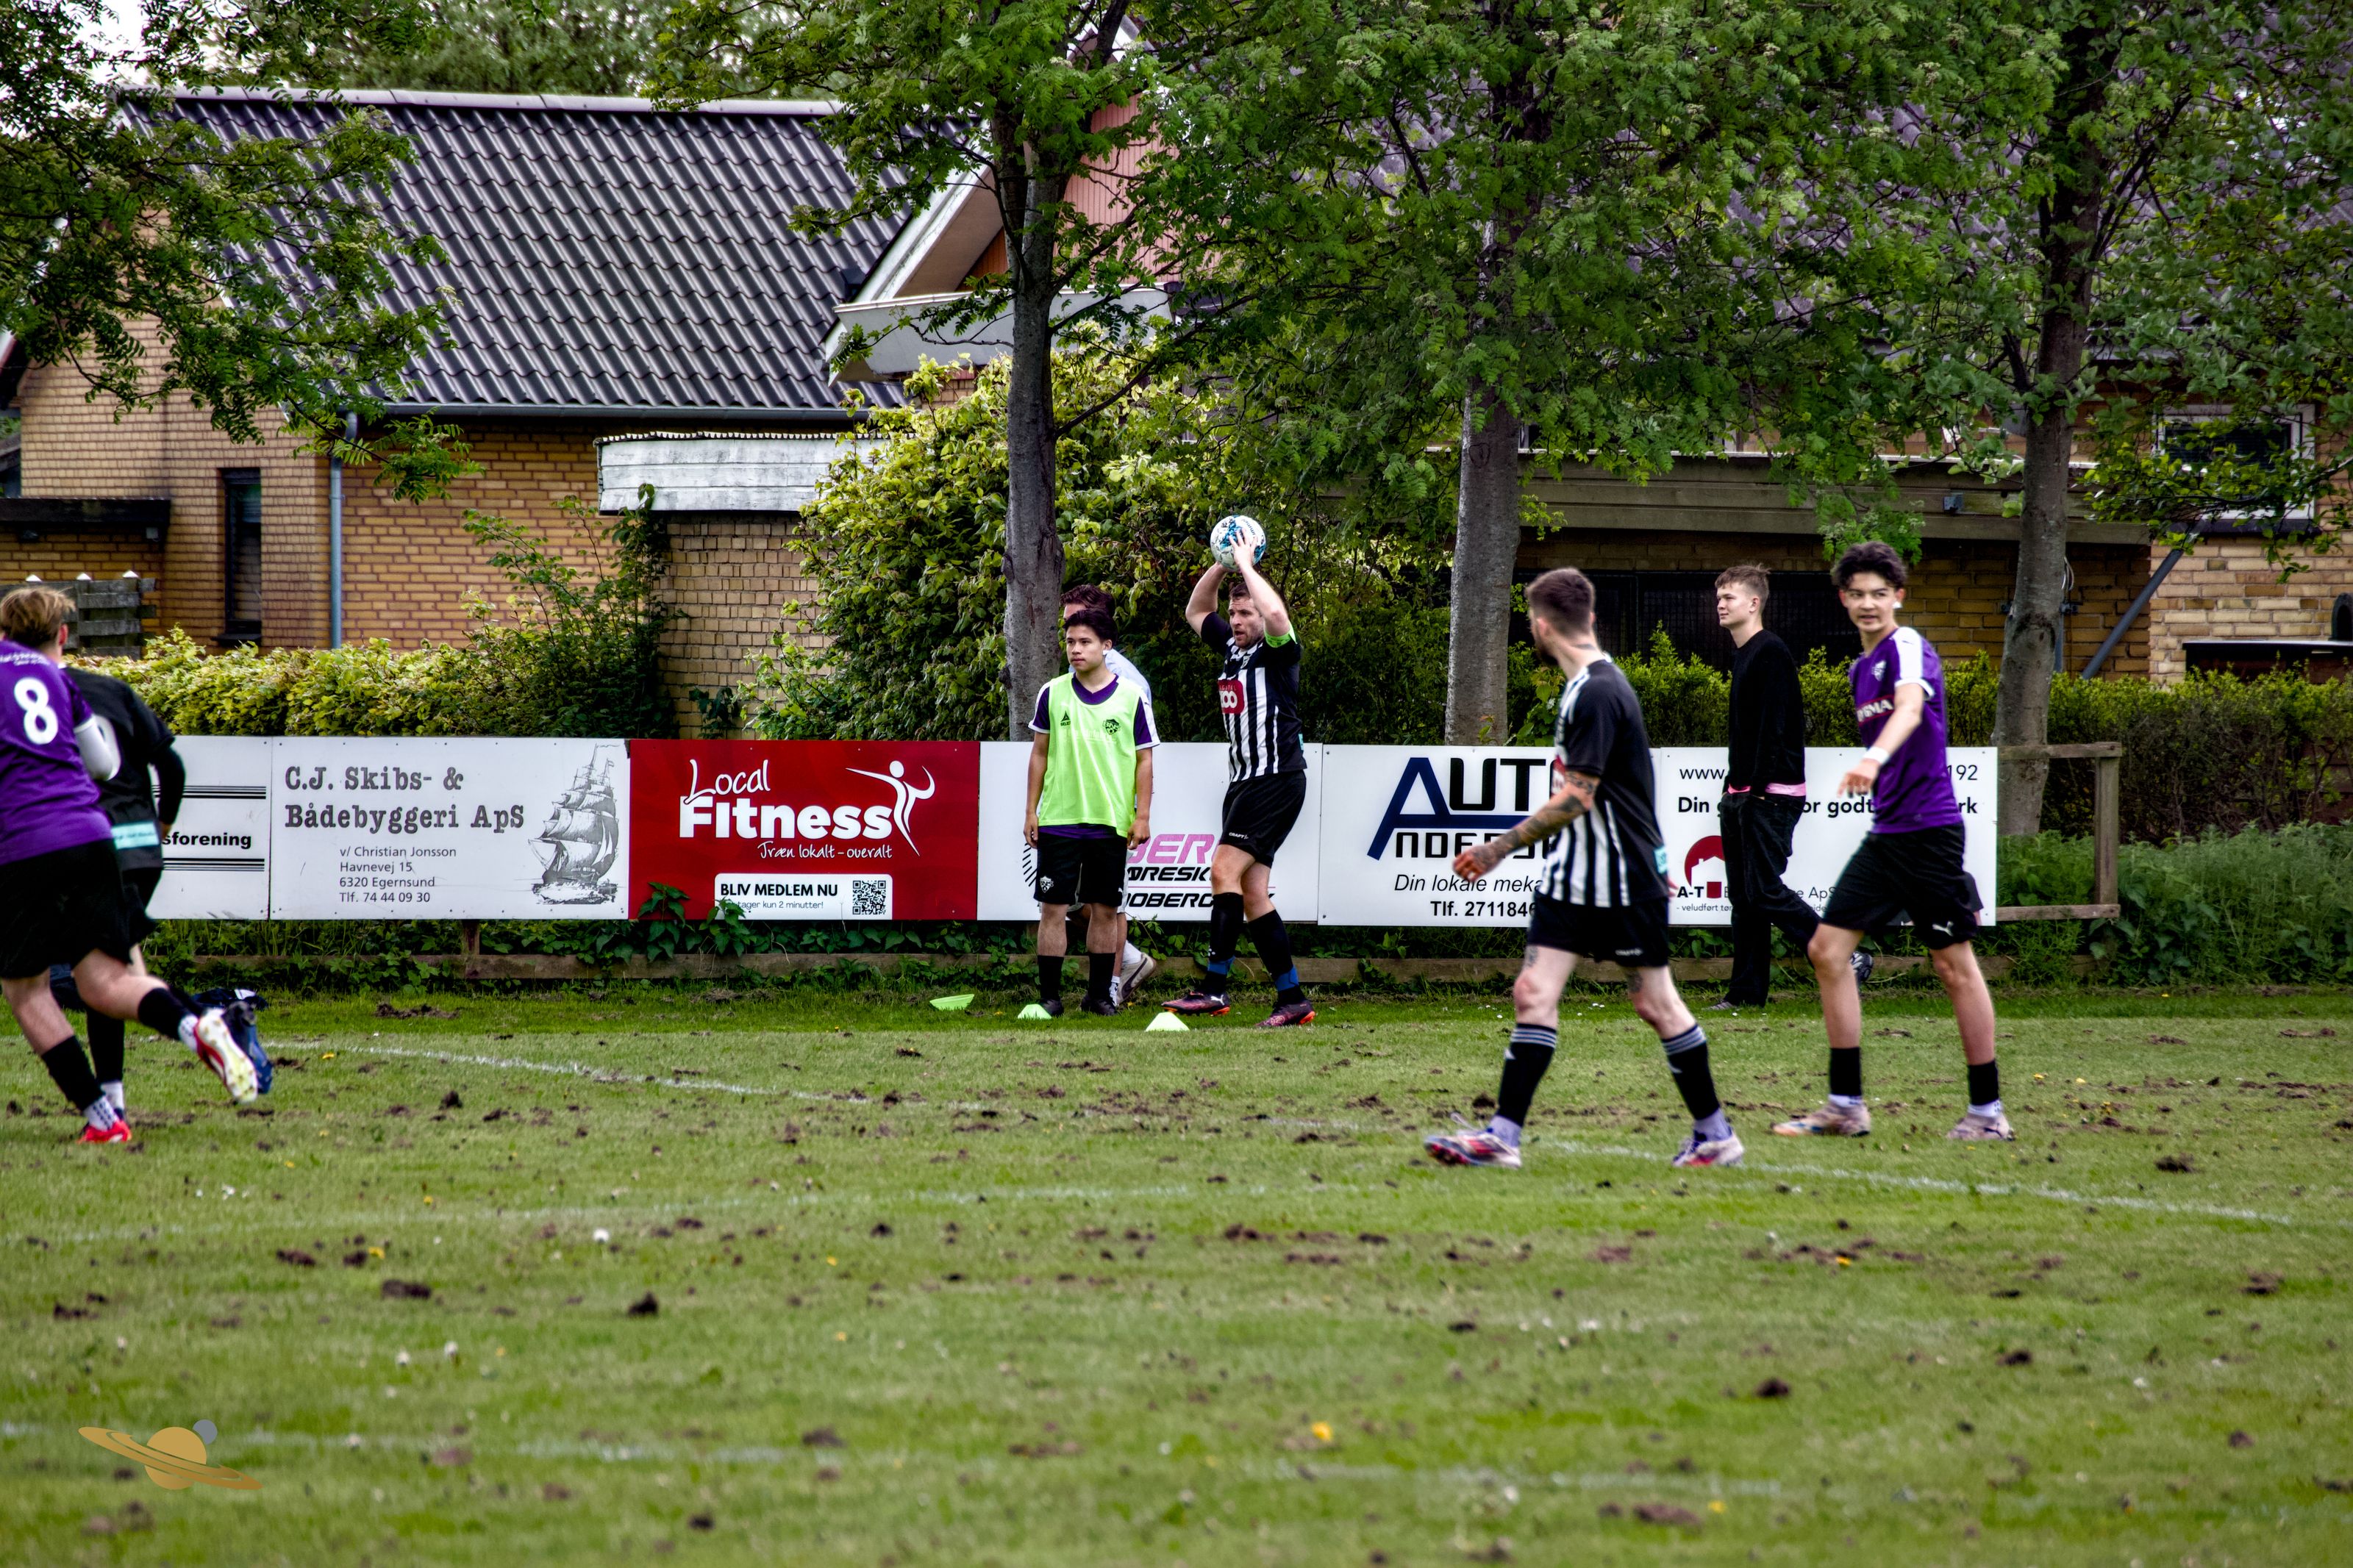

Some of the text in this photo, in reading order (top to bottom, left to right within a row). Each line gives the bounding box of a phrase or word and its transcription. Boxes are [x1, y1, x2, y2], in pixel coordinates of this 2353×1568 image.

[14, 677, 59, 745] 8
[285, 765, 464, 791] C.J. Skibs- &
[683, 759, 771, 805] Local
[1678, 796, 1710, 813] Din
[1827, 796, 1875, 818] godt
[285, 802, 524, 834] Bådebyggeri ApS
[679, 795, 893, 840] Fitness
[339, 845, 457, 858] v/ Christian Jonsson
[757, 840, 796, 859] Træn
[799, 844, 835, 859] lokalt
[846, 844, 893, 859] overalt
[340, 862, 413, 875] Havnevej 15
[339, 876, 435, 890] 6320 Egernsund
[721, 883, 838, 897] BLIV MEDLEM NU
[1394, 874, 1426, 891] Din
[1431, 874, 1487, 892] lokale
[339, 891, 431, 903] Tlf. 74 44 09 30
[1677, 886, 1704, 898] A-T
[763, 901, 777, 909] kun
[779, 901, 784, 909] 2
[785, 901, 824, 909] minutter!
[1429, 901, 1458, 917] Tlf.
[1682, 903, 1718, 912] veludført
